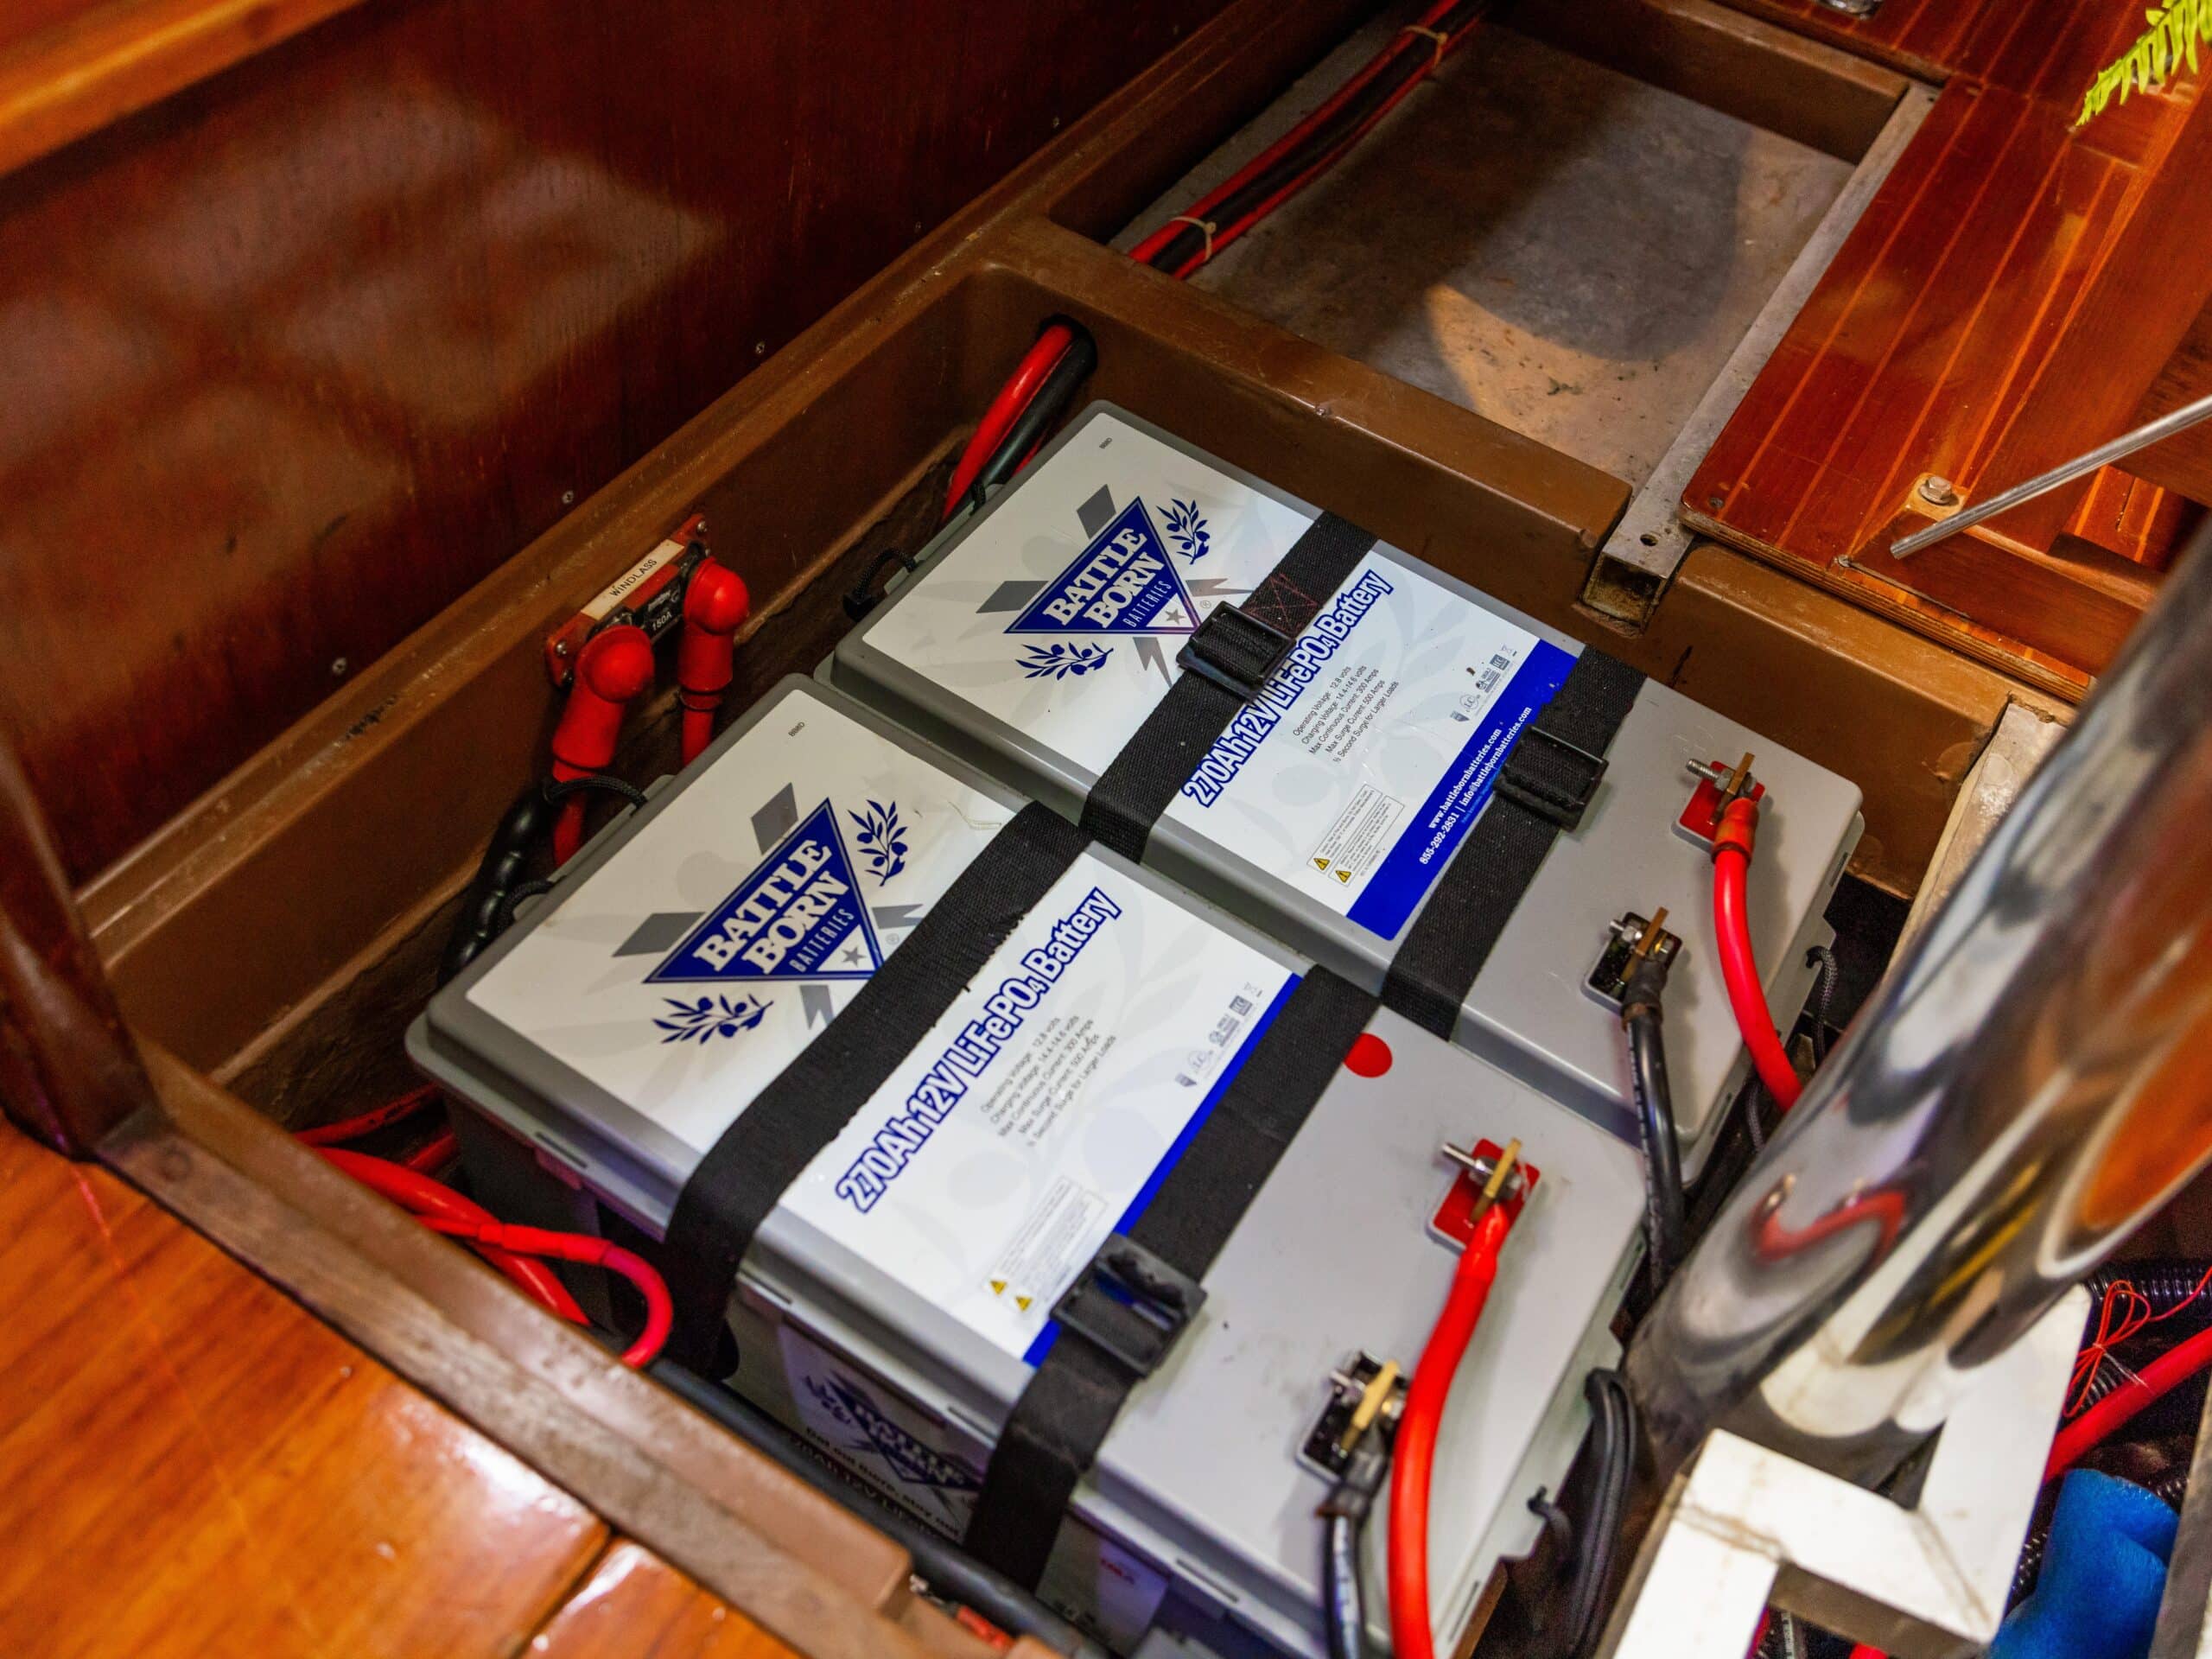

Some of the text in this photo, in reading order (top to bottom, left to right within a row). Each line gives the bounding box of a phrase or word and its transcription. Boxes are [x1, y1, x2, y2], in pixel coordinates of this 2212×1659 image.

[609, 559, 658, 597] WINDLASS
[1042, 528, 1147, 626] BATTLE
[1084, 552, 1165, 628] BORN
[1122, 580, 1173, 628] BATTERIES
[1313, 569, 1394, 642] Battery
[652, 611, 672, 631] 150A
[1292, 665, 1351, 736] Operating Voltage: 12.8 volts
[1301, 720, 1325, 744] Charging
[1319, 701, 1338, 720] Voltage:
[1354, 665, 1367, 677] volts
[1308, 741, 1322, 753] Max
[1318, 712, 1344, 742] Continuous
[1341, 692, 1359, 712] Current:
[1363, 668, 1378, 683] Amps
[1325, 679, 1385, 753] Max Surge Current: 500 Amps
[1337, 735, 1357, 757] Second
[1352, 720, 1369, 736] Surge
[1364, 712, 1373, 721] for
[1370, 696, 1386, 714] Larger
[1383, 681, 1399, 697] Loads
[1419, 811, 1459, 864] 855-292-2831
[1458, 706, 1532, 806] info@battlebornbatteries.com
[1427, 728, 1502, 828] www.battlebornbatteries.com
[692, 839, 832, 972] BATTLE
[741, 870, 849, 975] BORN
[789, 907, 855, 973] BATTERIES
[1020, 887, 1122, 983] Battery
